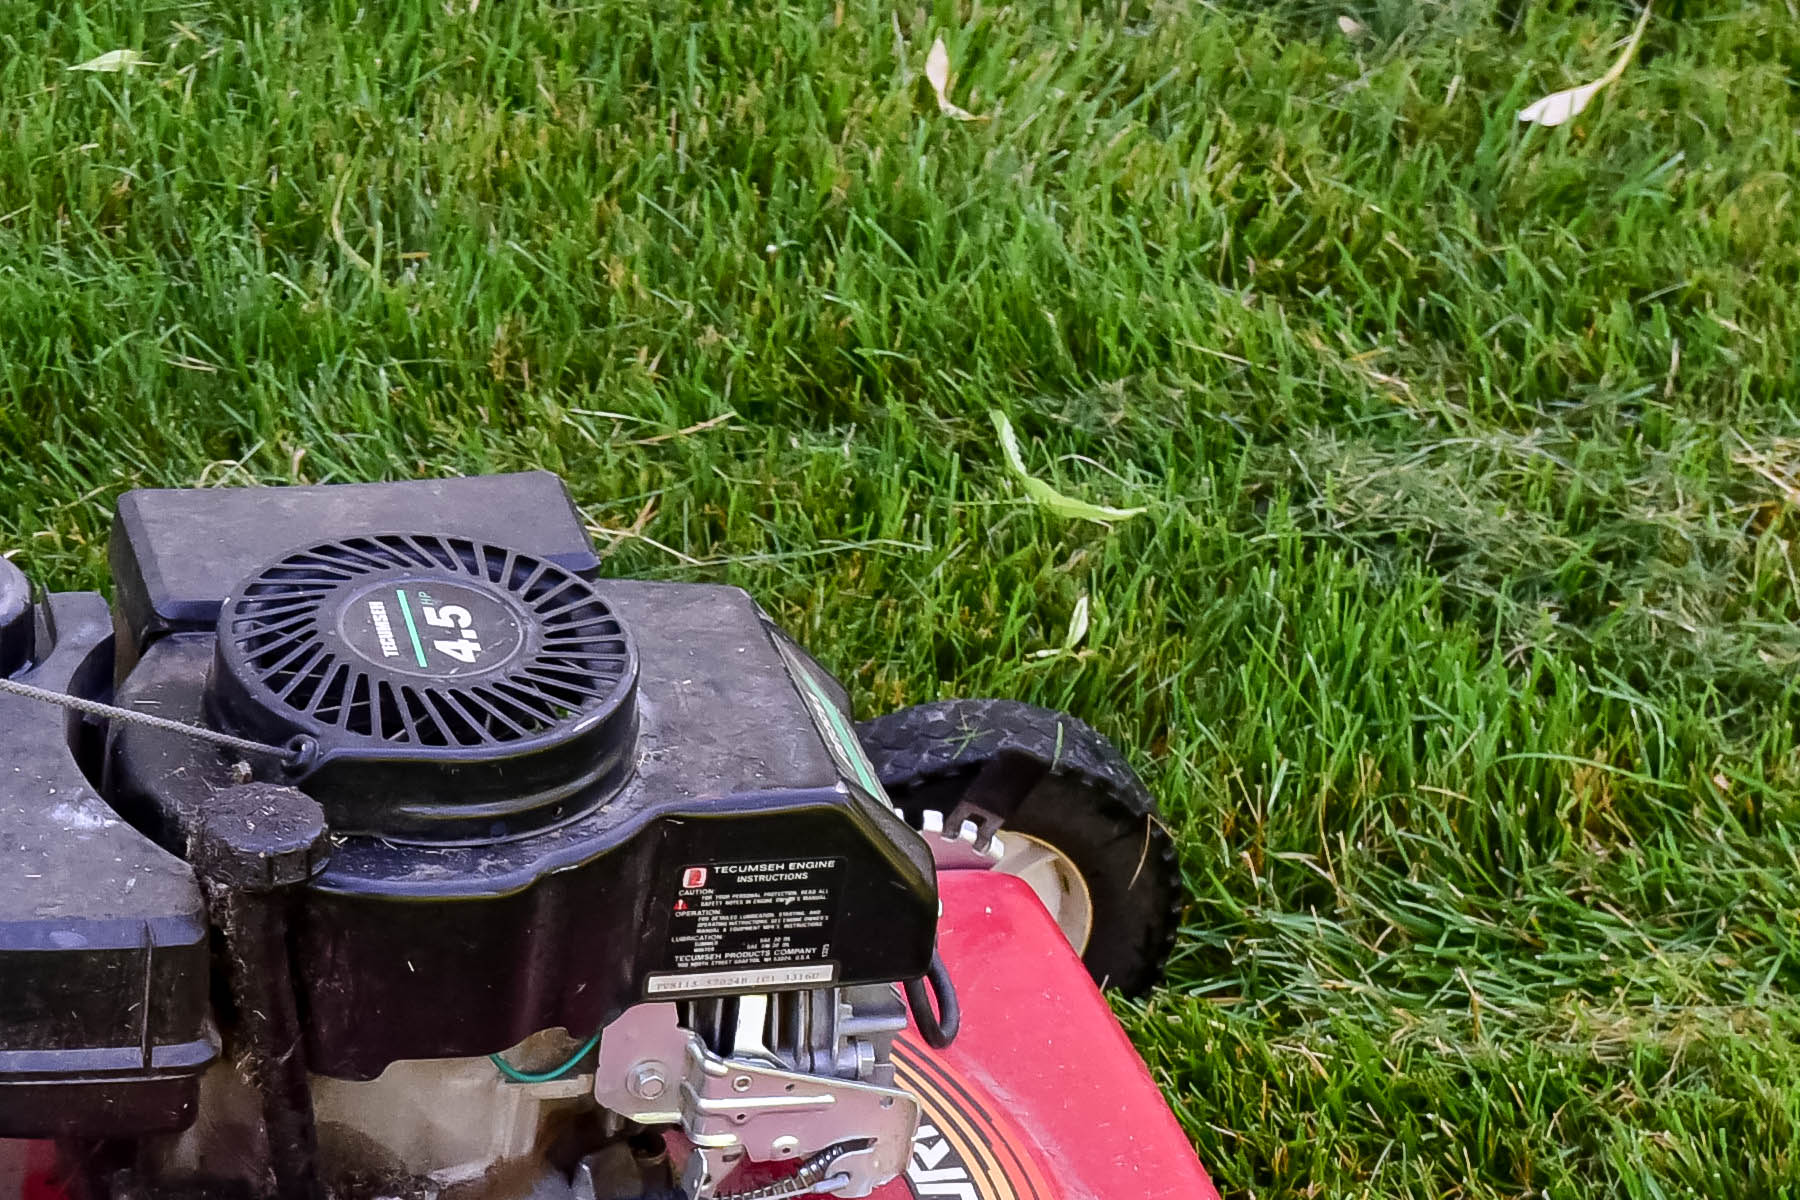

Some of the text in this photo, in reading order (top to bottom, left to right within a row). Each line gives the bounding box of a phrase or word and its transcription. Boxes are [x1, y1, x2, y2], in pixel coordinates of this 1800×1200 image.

[419, 591, 435, 606] HP
[368, 601, 399, 657] TECUMSEH
[423, 605, 482, 663] 4.5
[715, 860, 834, 873] TECUMSEH ENGINE
[737, 872, 808, 882] INSTRUCTIONS
[725, 950, 770, 958] PRODUCTS
